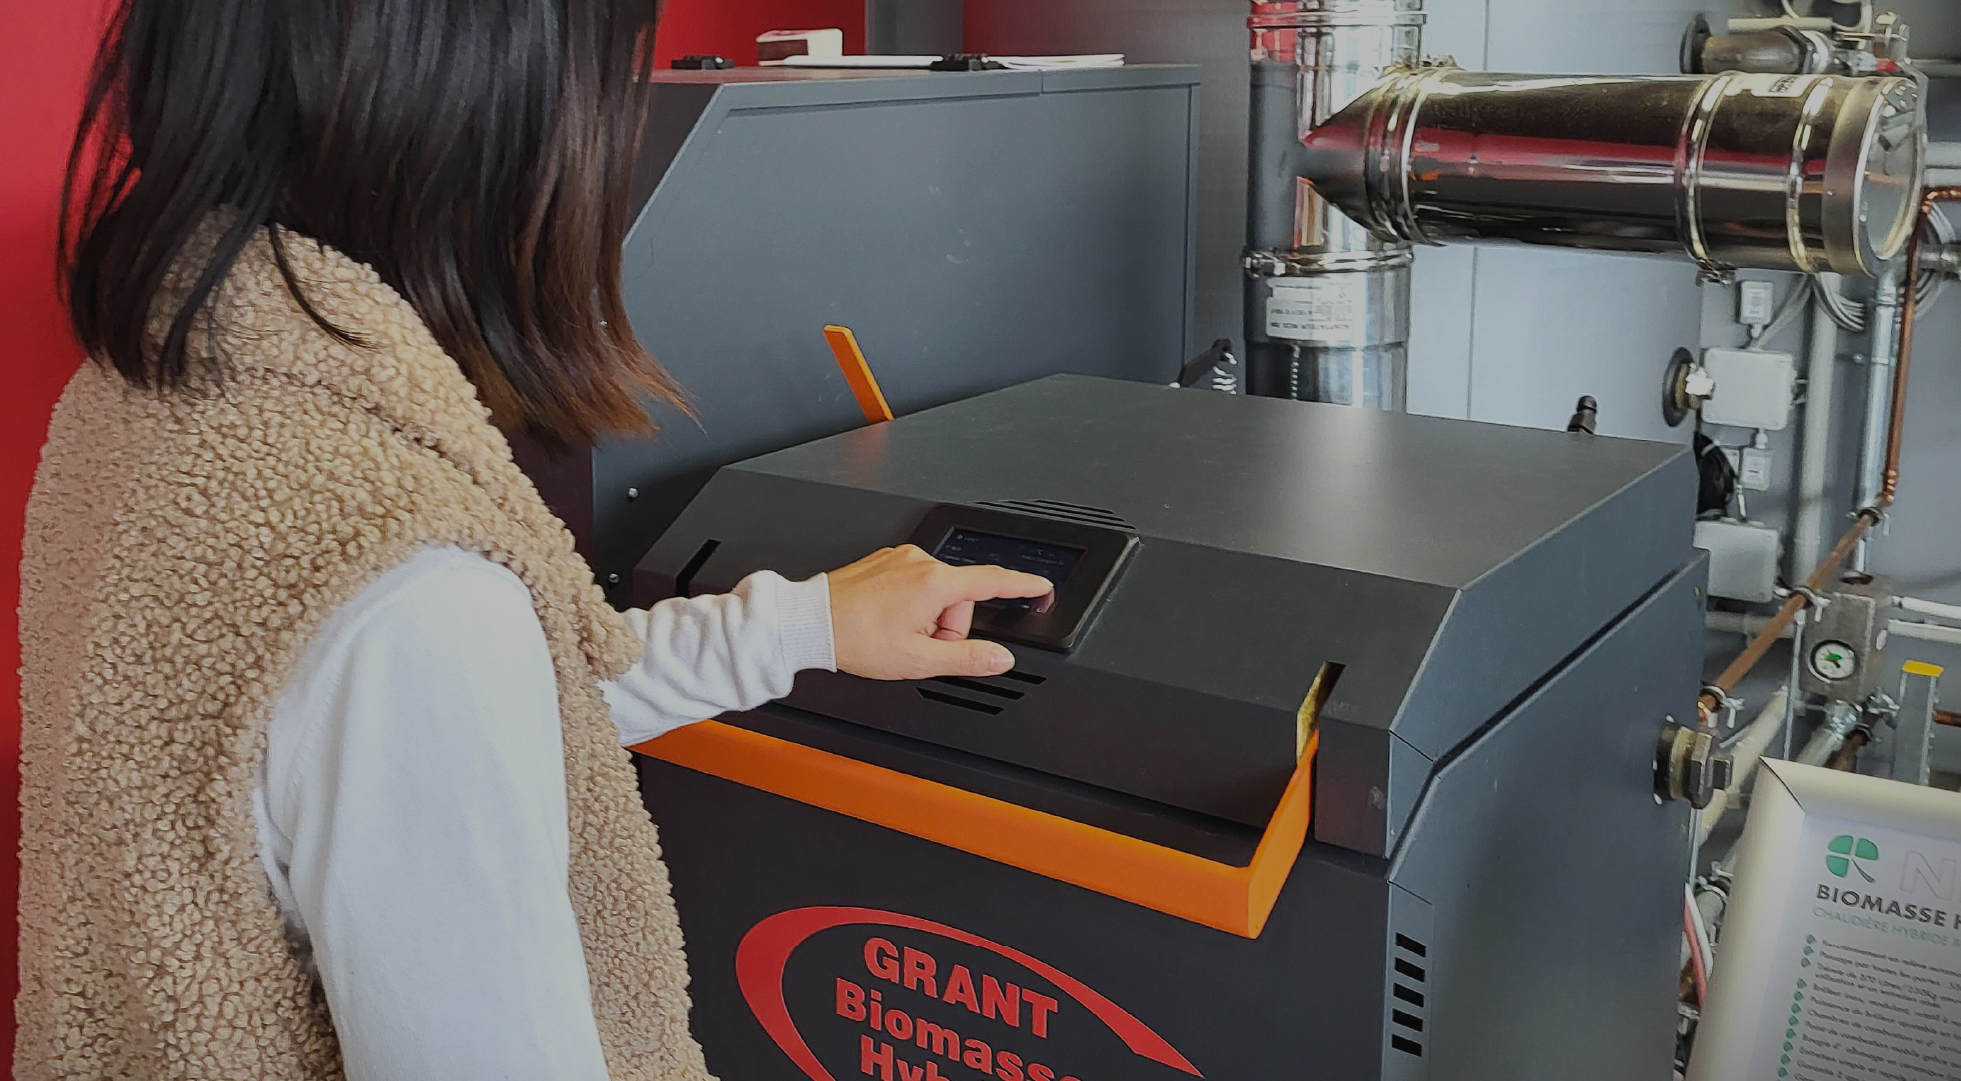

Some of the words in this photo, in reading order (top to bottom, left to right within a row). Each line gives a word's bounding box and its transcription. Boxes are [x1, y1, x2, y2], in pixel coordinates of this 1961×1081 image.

[1816, 884, 1947, 927] BIOMASSE
[835, 978, 1079, 1081] Biomass
[864, 937, 1059, 1039] GRANT
